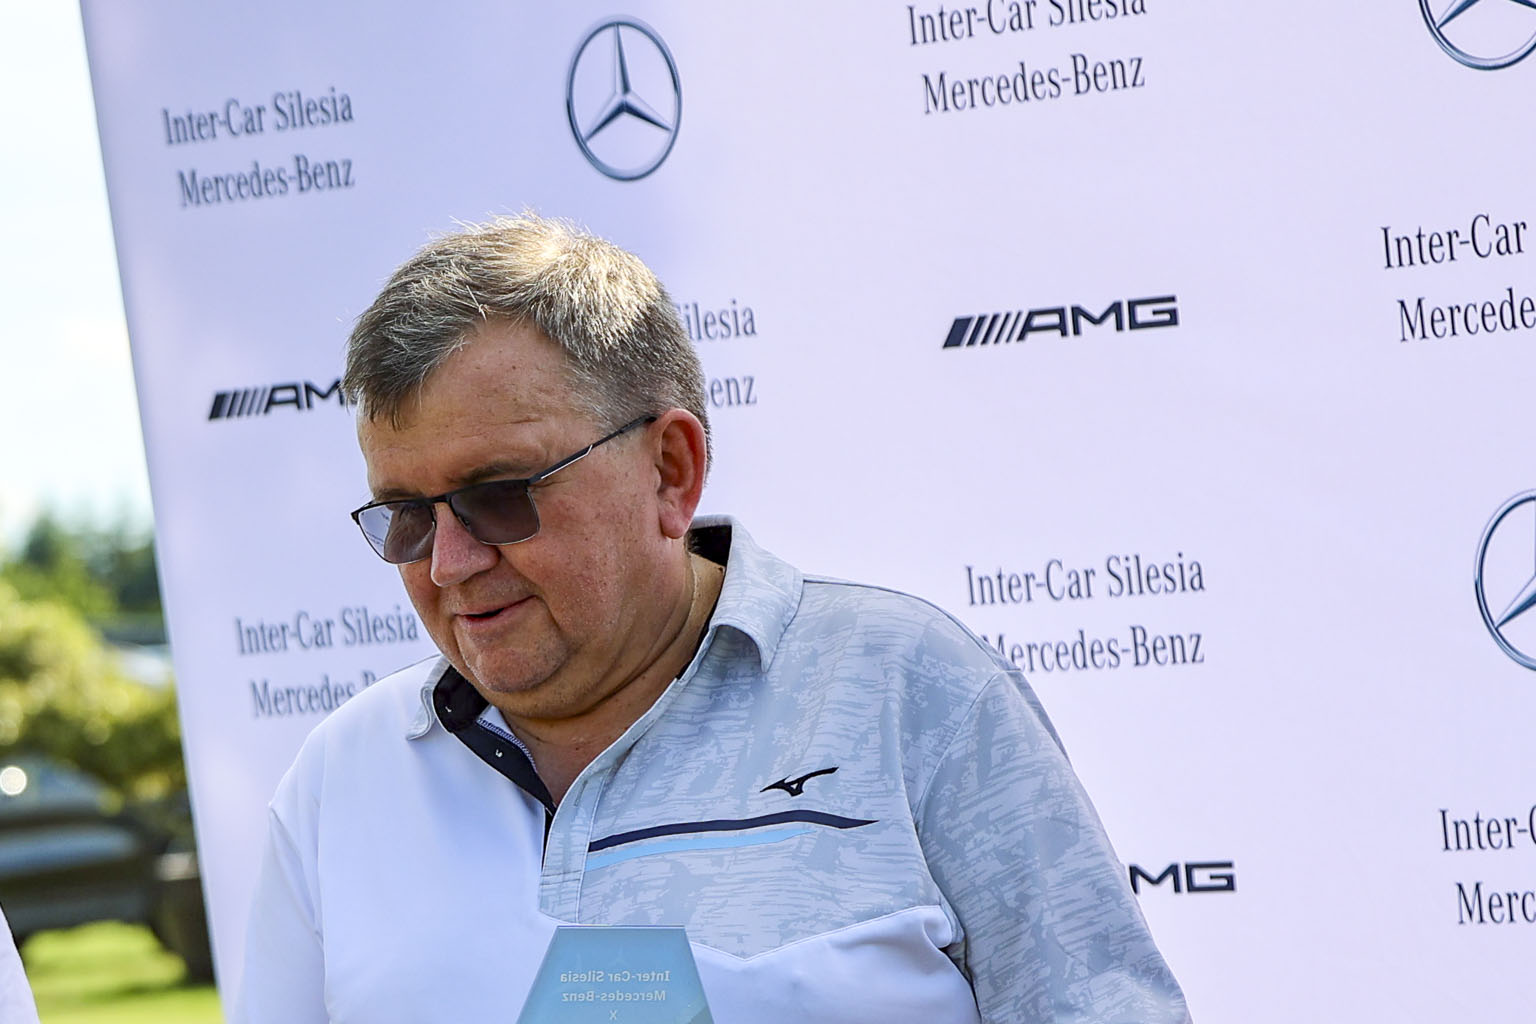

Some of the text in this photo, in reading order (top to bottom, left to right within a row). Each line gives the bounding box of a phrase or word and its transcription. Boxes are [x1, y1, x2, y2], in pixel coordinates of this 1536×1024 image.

[907, 0, 1037, 46] Inter-Car
[922, 53, 1146, 115] Mercedes-Benz
[162, 86, 354, 145] Inter-Car Silesia
[178, 154, 355, 208] Mercedes-Benz
[1380, 213, 1527, 269] Inter-Car
[676, 299, 758, 341] ilesia
[1017, 295, 1180, 342] AMG
[705, 375, 758, 408] enz
[965, 551, 1206, 606] Inter-Car Silesia
[234, 604, 420, 655] Inter-Car Silesia
[250, 669, 377, 718] Mercedes
[1129, 861, 1235, 894] MG
